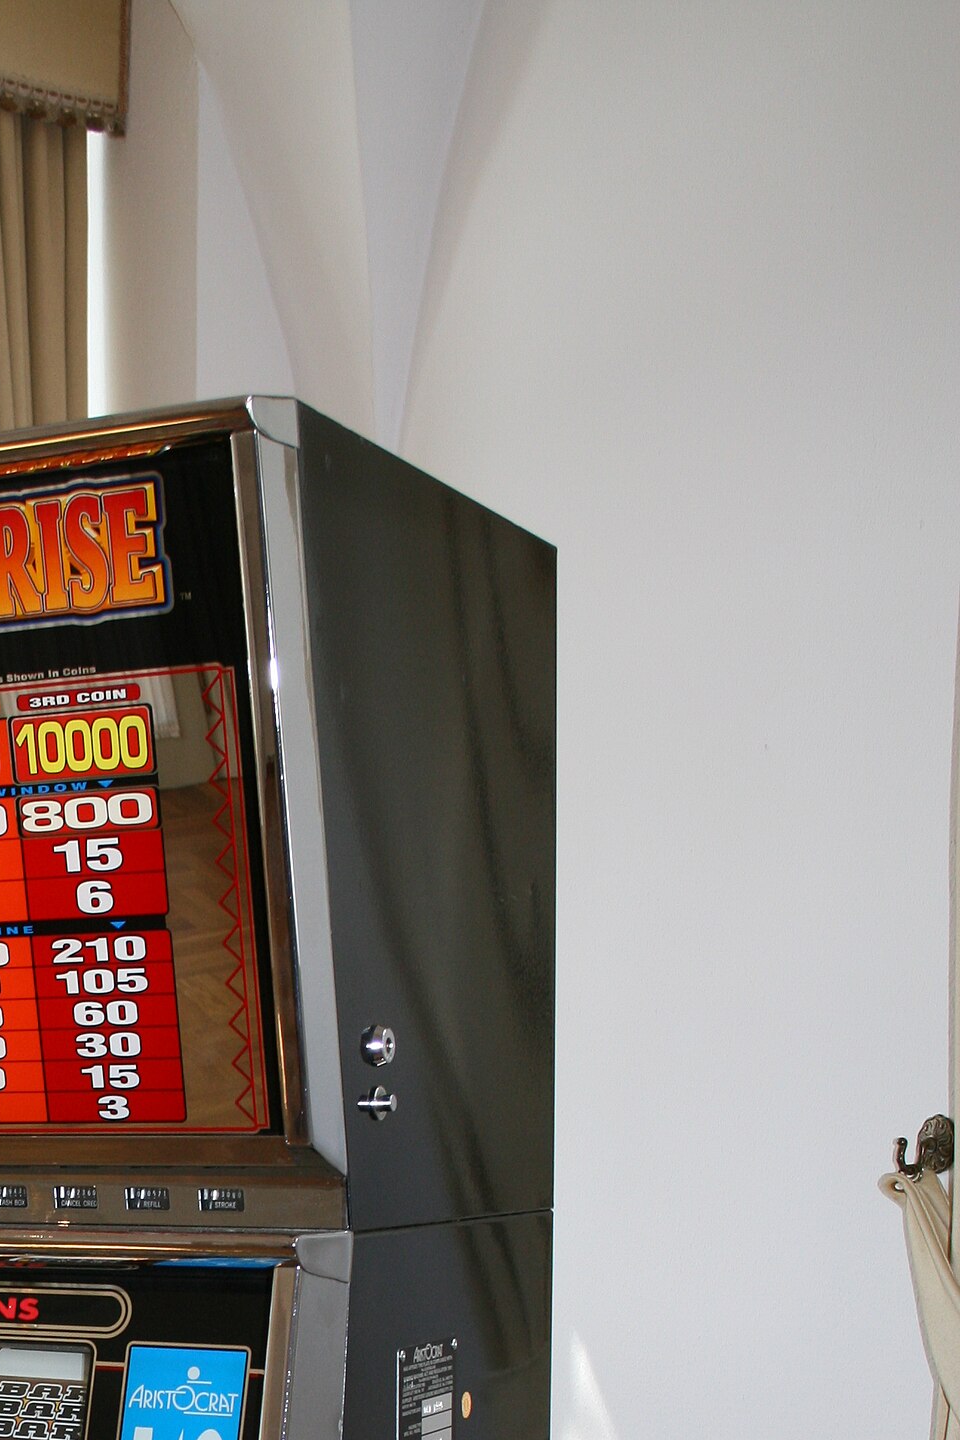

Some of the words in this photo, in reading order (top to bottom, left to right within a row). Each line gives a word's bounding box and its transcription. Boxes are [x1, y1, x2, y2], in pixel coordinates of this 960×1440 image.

[6, 672, 44, 683] Shown
[62, 665, 96, 677] Coins
[29, 694, 70, 708] 3RD
[76, 688, 127, 703] COIN
[15, 715, 150, 776] 10000
[20, 792, 155, 834] 800
[52, 837, 124, 874] 15
[75, 880, 115, 915] 6
[51, 935, 147, 964] 210
[54, 967, 149, 996] 105
[73, 999, 140, 1027] 60
[75, 1031, 143, 1058] 30
[81, 1062, 142, 1090] 15
[97, 1095, 131, 1122] 3
[143, 1201, 161, 1209] REFILL
[214, 1201, 237, 1210] STROKE
[128, 1384, 239, 1414] ARISTOCRAT
